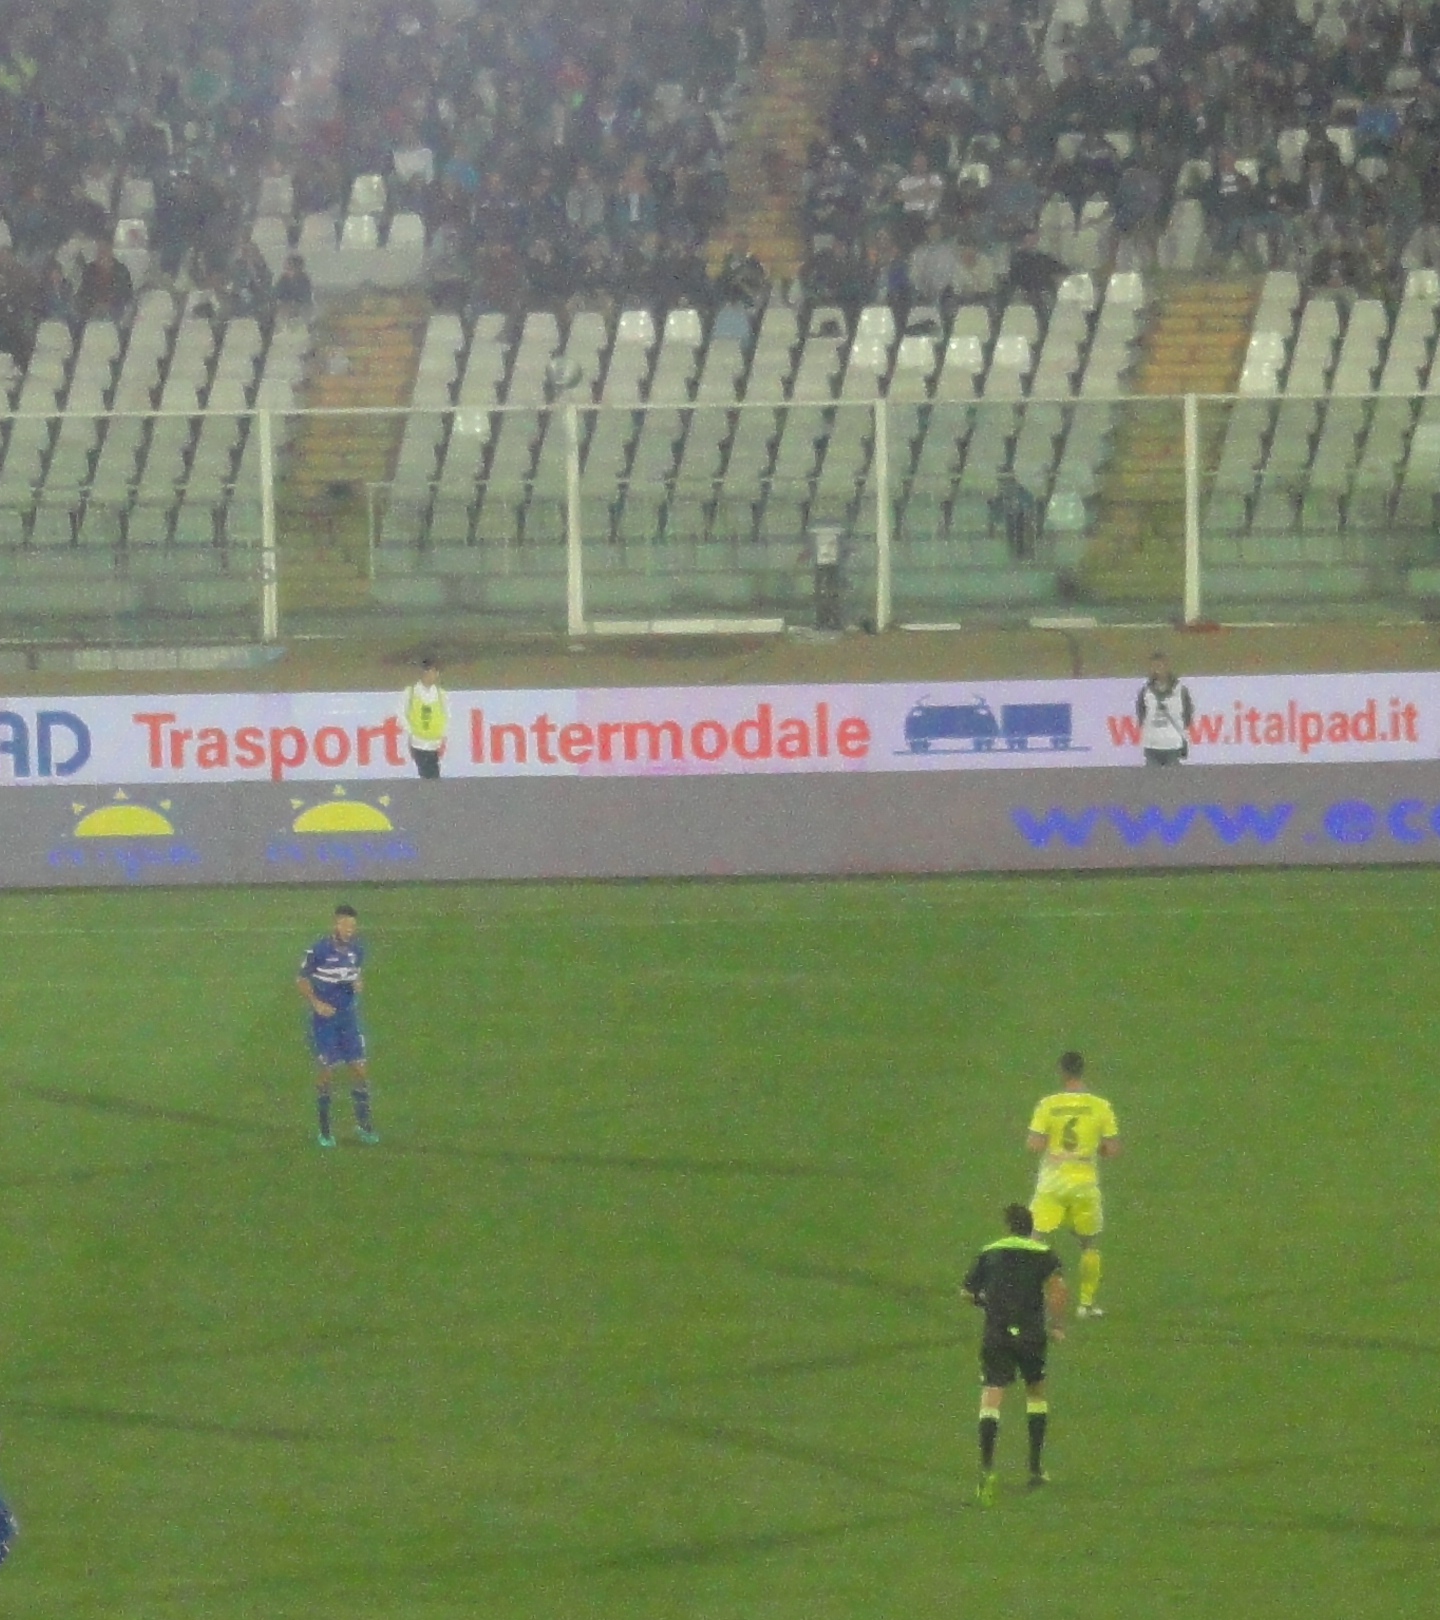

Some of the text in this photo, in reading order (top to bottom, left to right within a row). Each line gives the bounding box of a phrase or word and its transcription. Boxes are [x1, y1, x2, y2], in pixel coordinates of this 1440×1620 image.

[133, 702, 870, 782] Trasport Intermodale
[1106, 697, 1418, 753] ww.italpad.it
